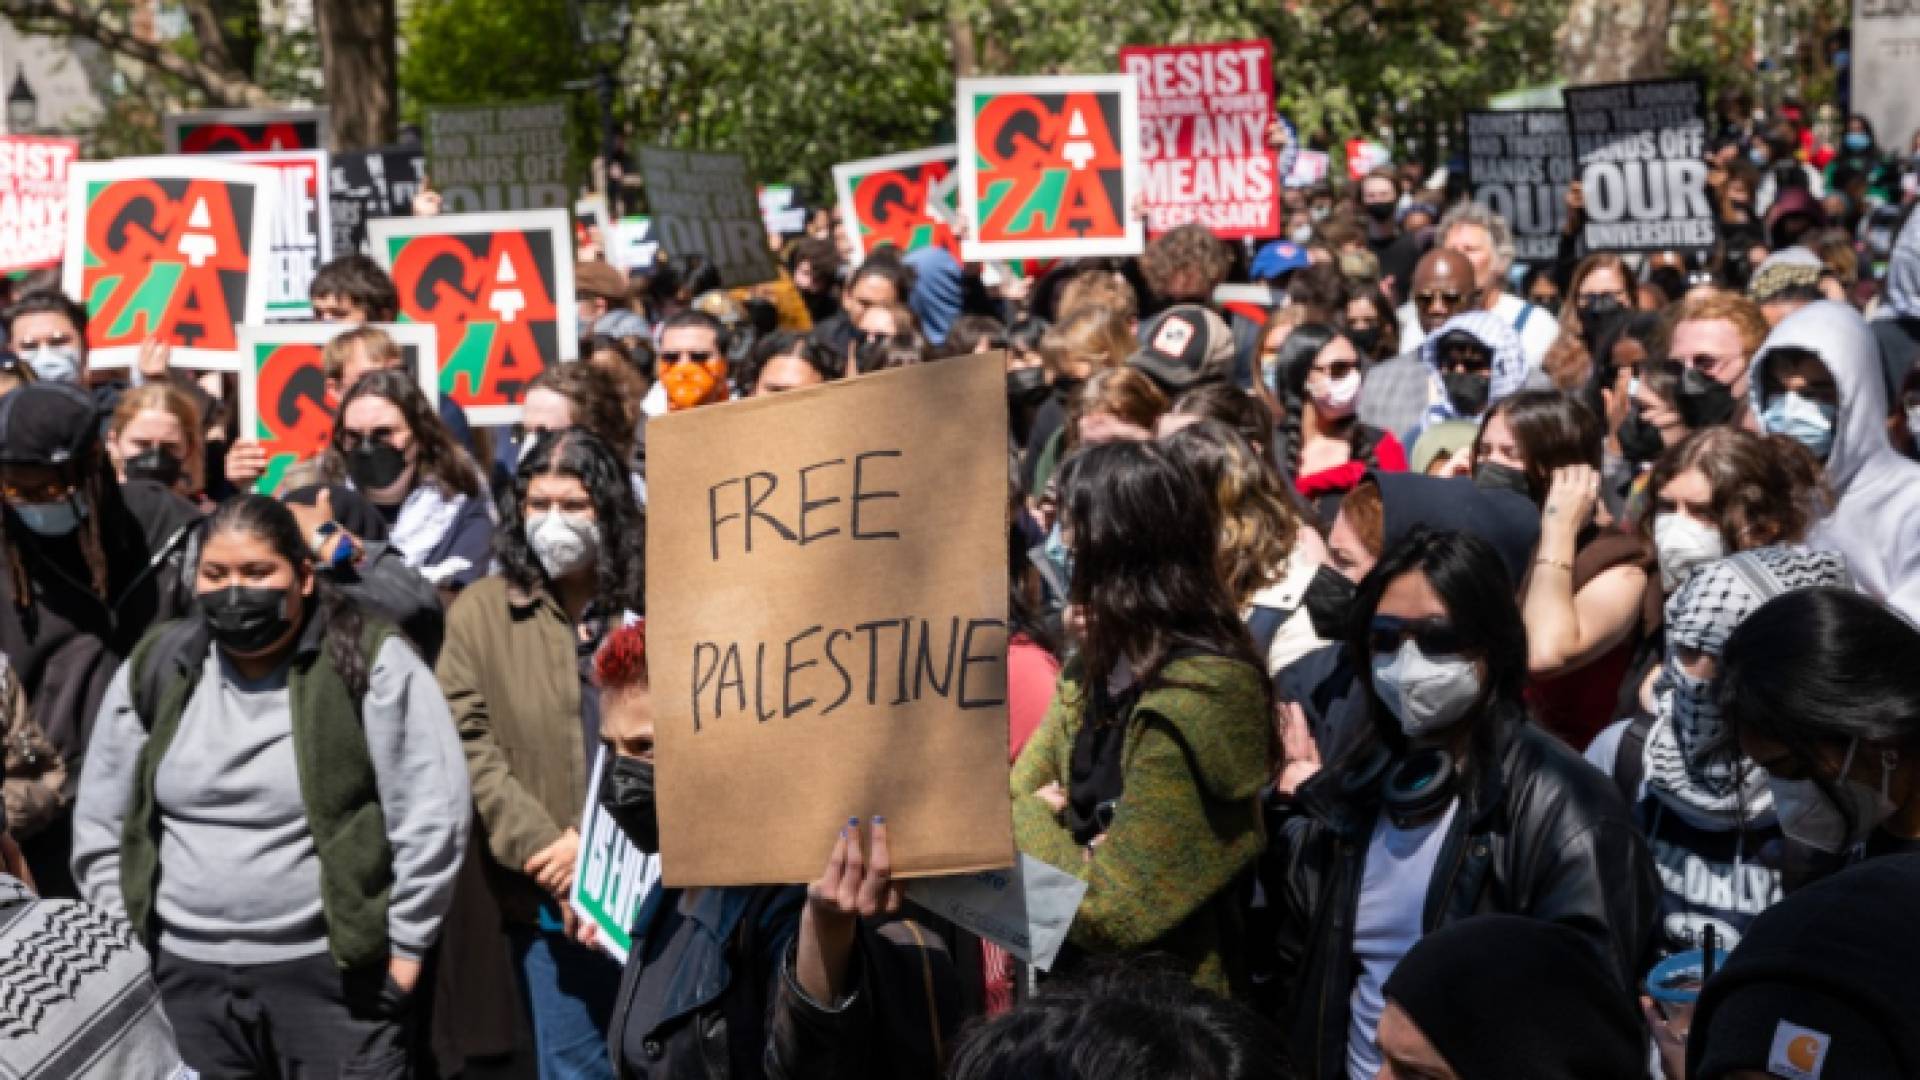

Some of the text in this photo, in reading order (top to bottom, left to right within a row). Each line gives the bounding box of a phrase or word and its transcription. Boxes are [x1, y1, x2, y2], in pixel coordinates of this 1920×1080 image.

[1126, 48, 1264, 97] RESIST
[1139, 111, 1267, 159] BY ANY
[1660, 124, 1704, 159] OFF
[1140, 155, 1273, 204] MEANS
[1581, 158, 1711, 222] OUR
[1583, 218, 1715, 249] UNIVERSITIES
[706, 449, 903, 562] FREE
[690, 615, 1006, 733] PALESTINE
